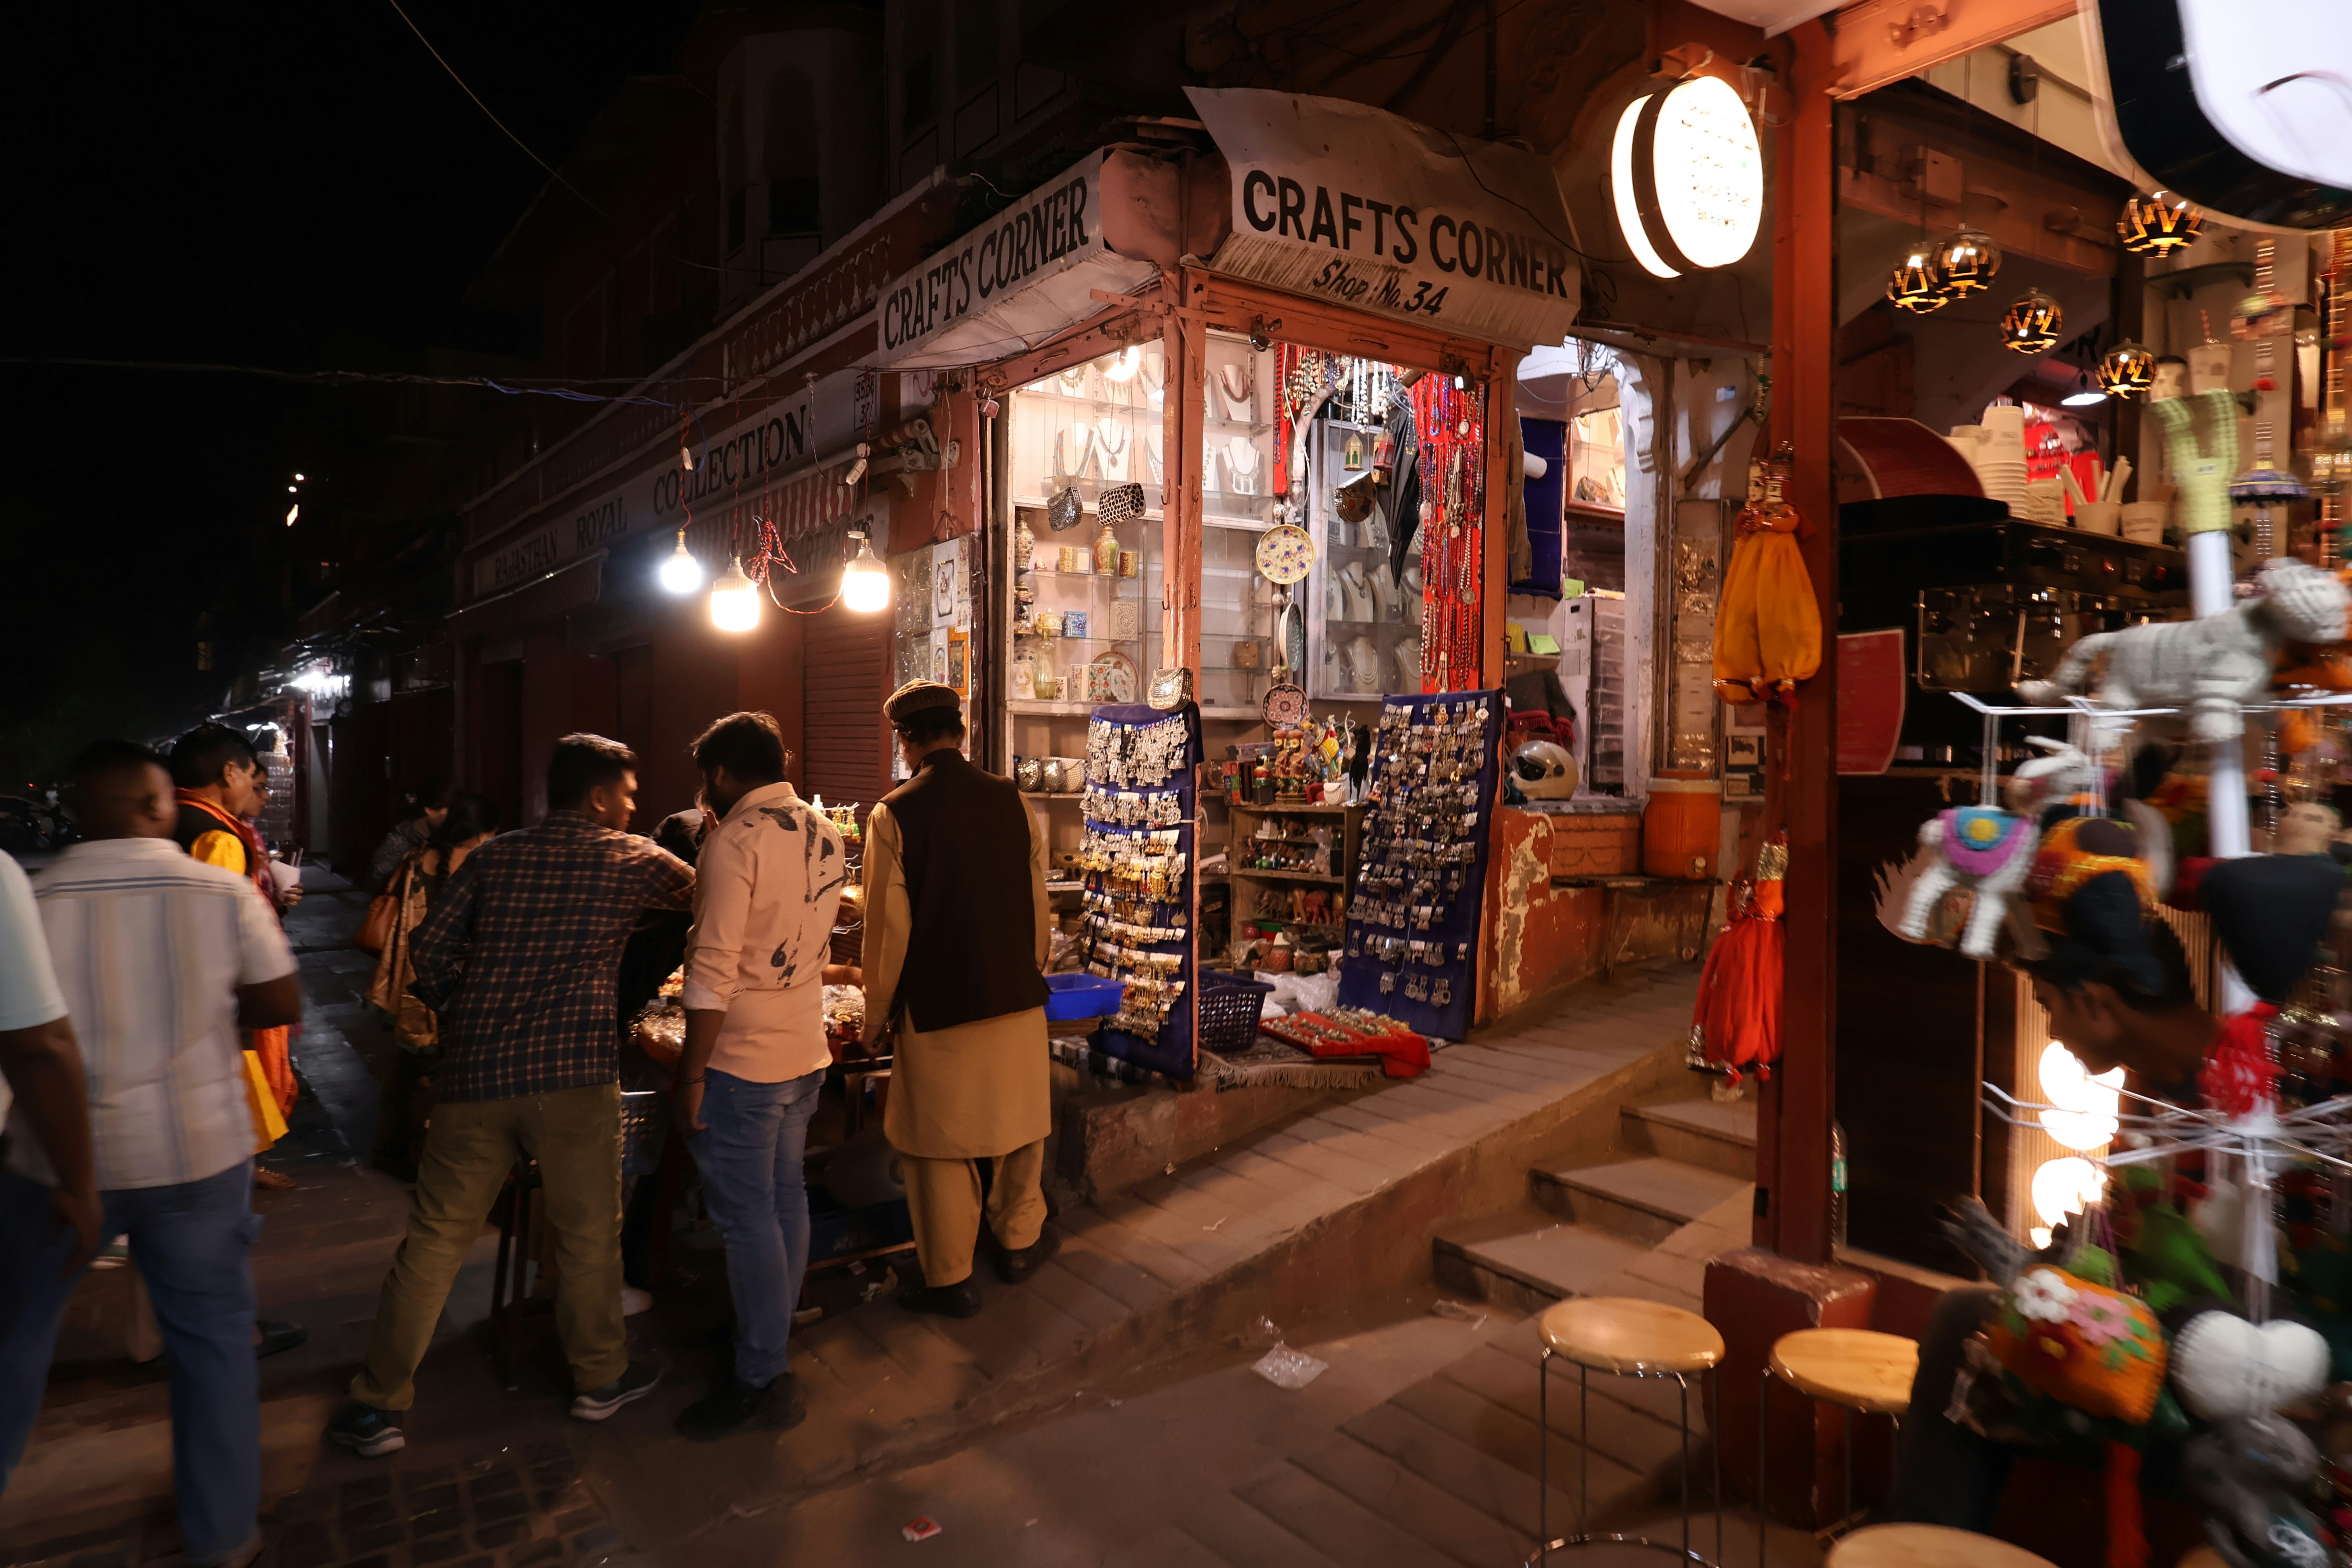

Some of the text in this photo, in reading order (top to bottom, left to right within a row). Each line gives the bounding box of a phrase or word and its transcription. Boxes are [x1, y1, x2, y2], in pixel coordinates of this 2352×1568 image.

[885, 176, 1089, 350] CRAFTS CORNER
[1243, 169, 1568, 299] CRAFTS CORNER
[495, 405, 806, 585] RAJASTHAN ROYAL COLLECTION
